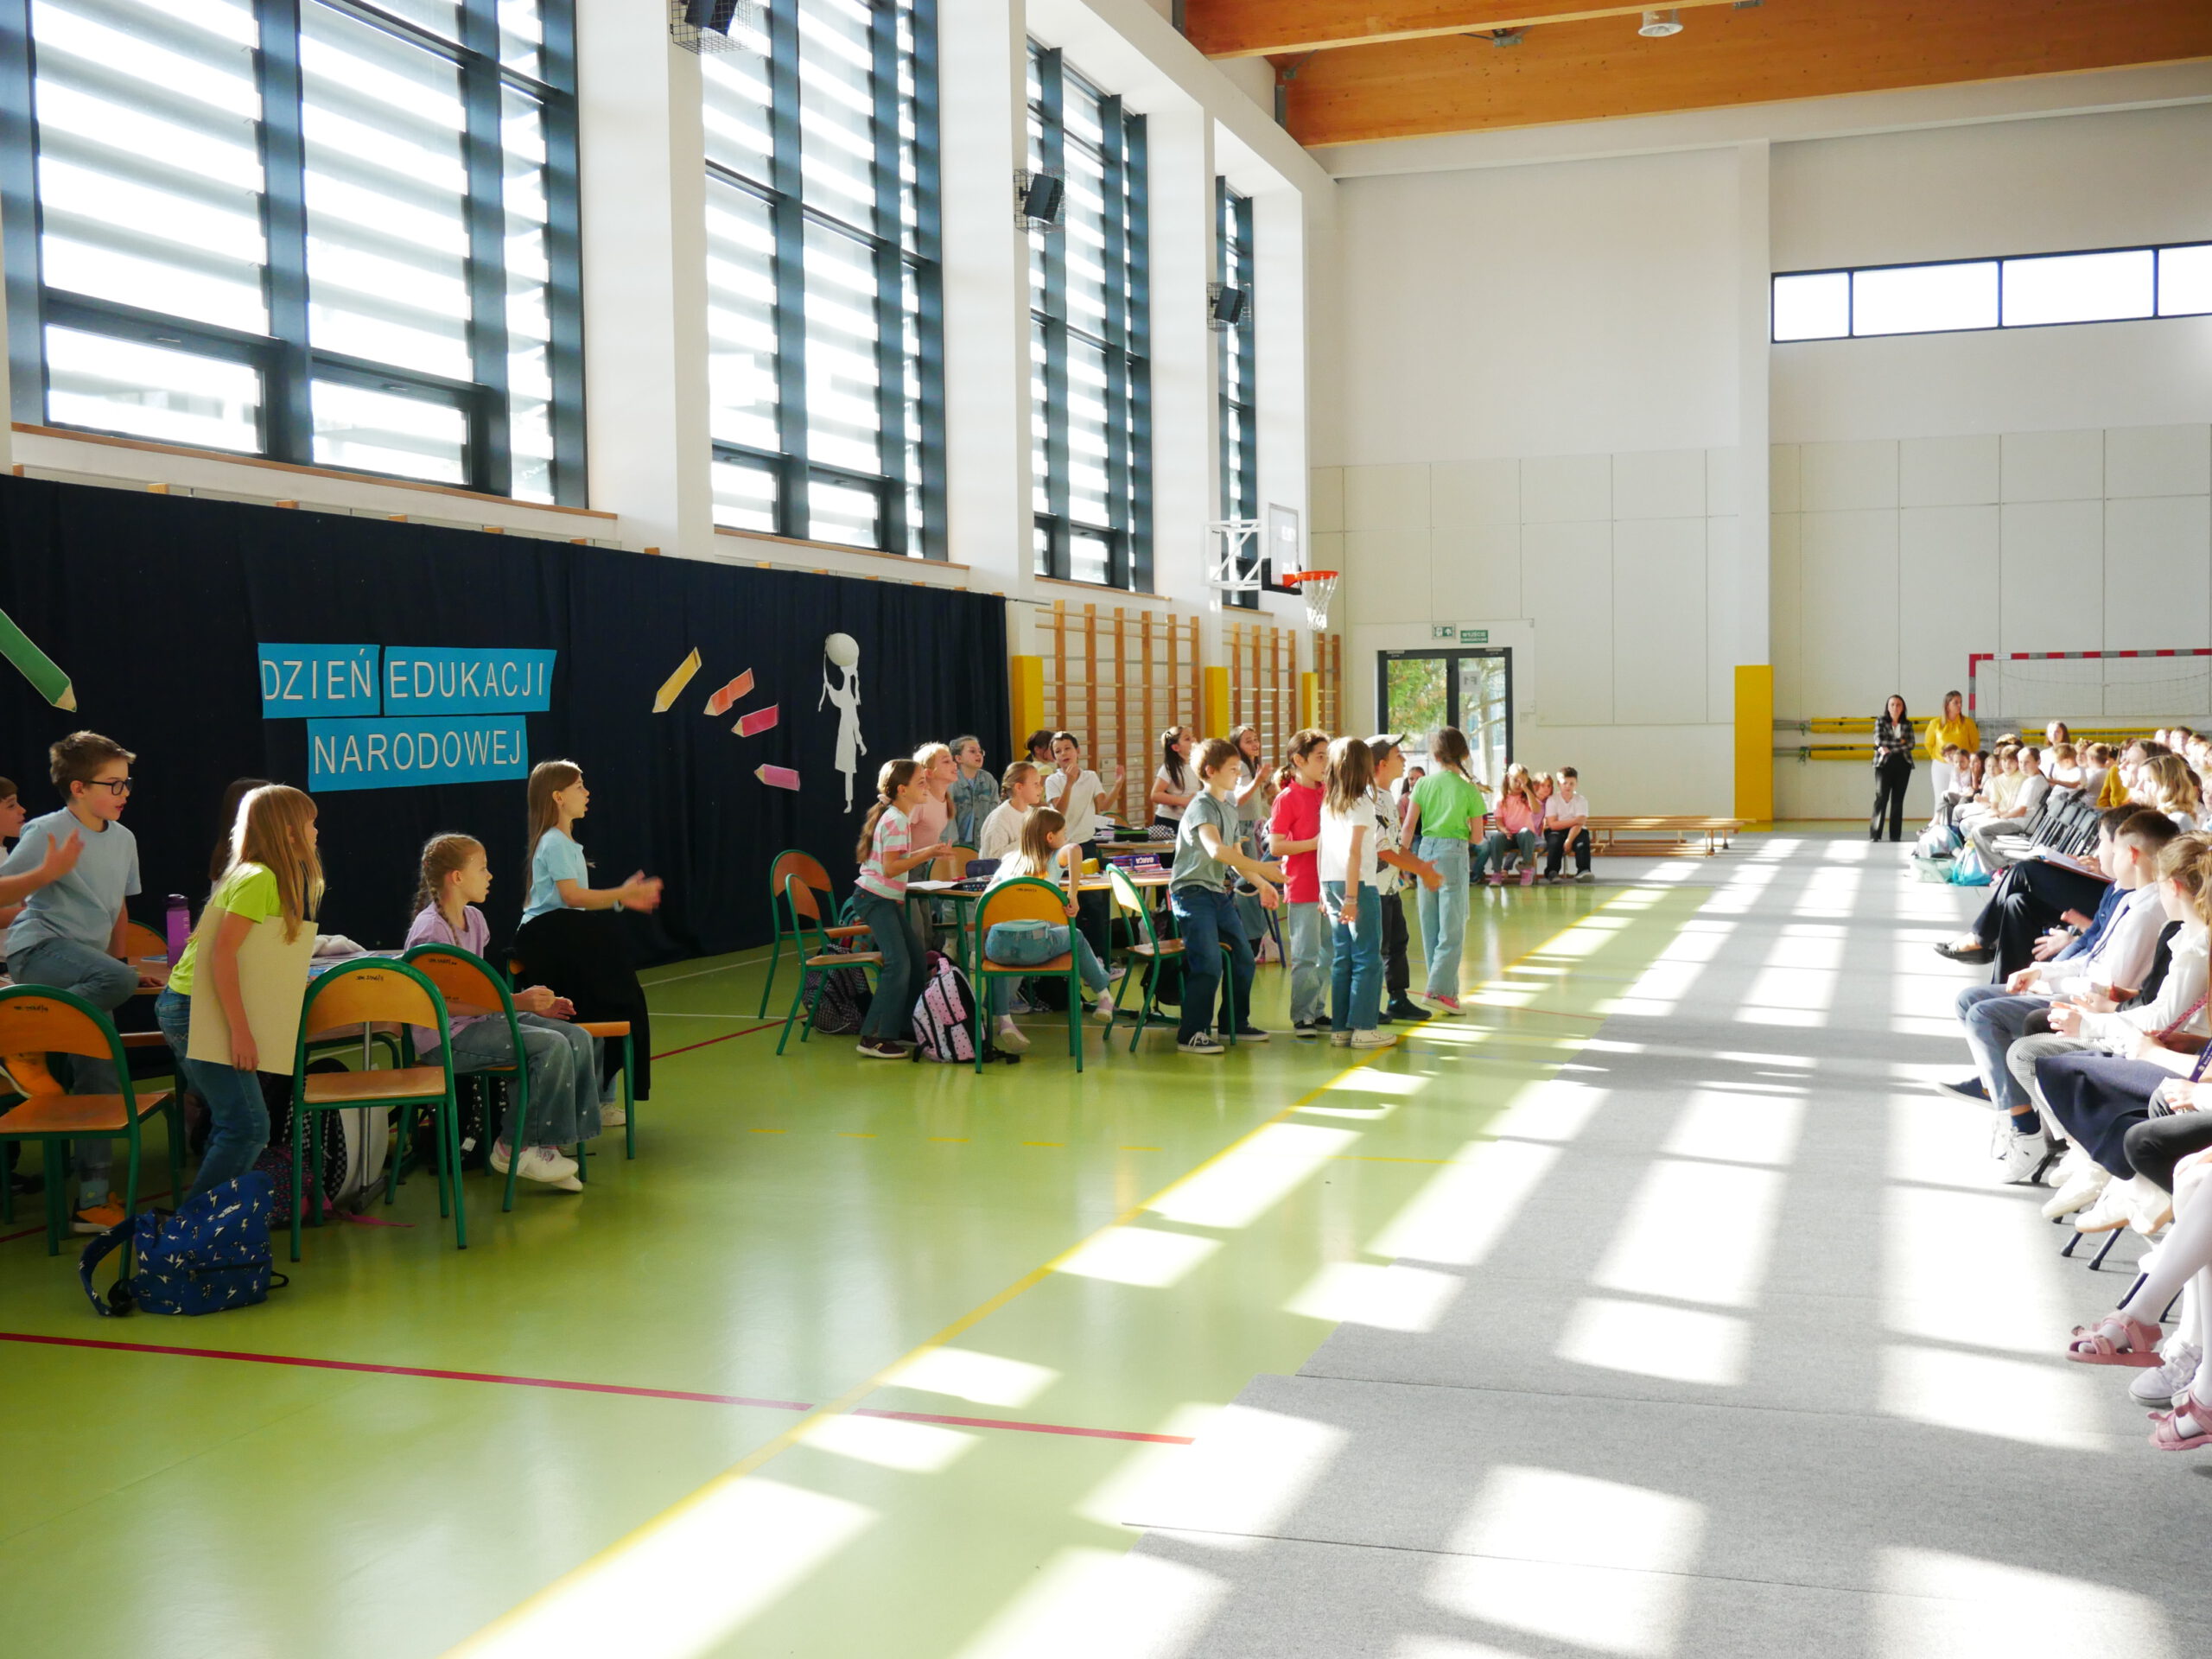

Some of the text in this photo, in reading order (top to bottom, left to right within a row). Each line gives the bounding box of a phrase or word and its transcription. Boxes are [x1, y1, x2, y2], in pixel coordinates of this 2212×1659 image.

[262, 648, 543, 700] DZIEŃ EDUKACJI
[315, 730, 520, 774] NARODOWEJ
